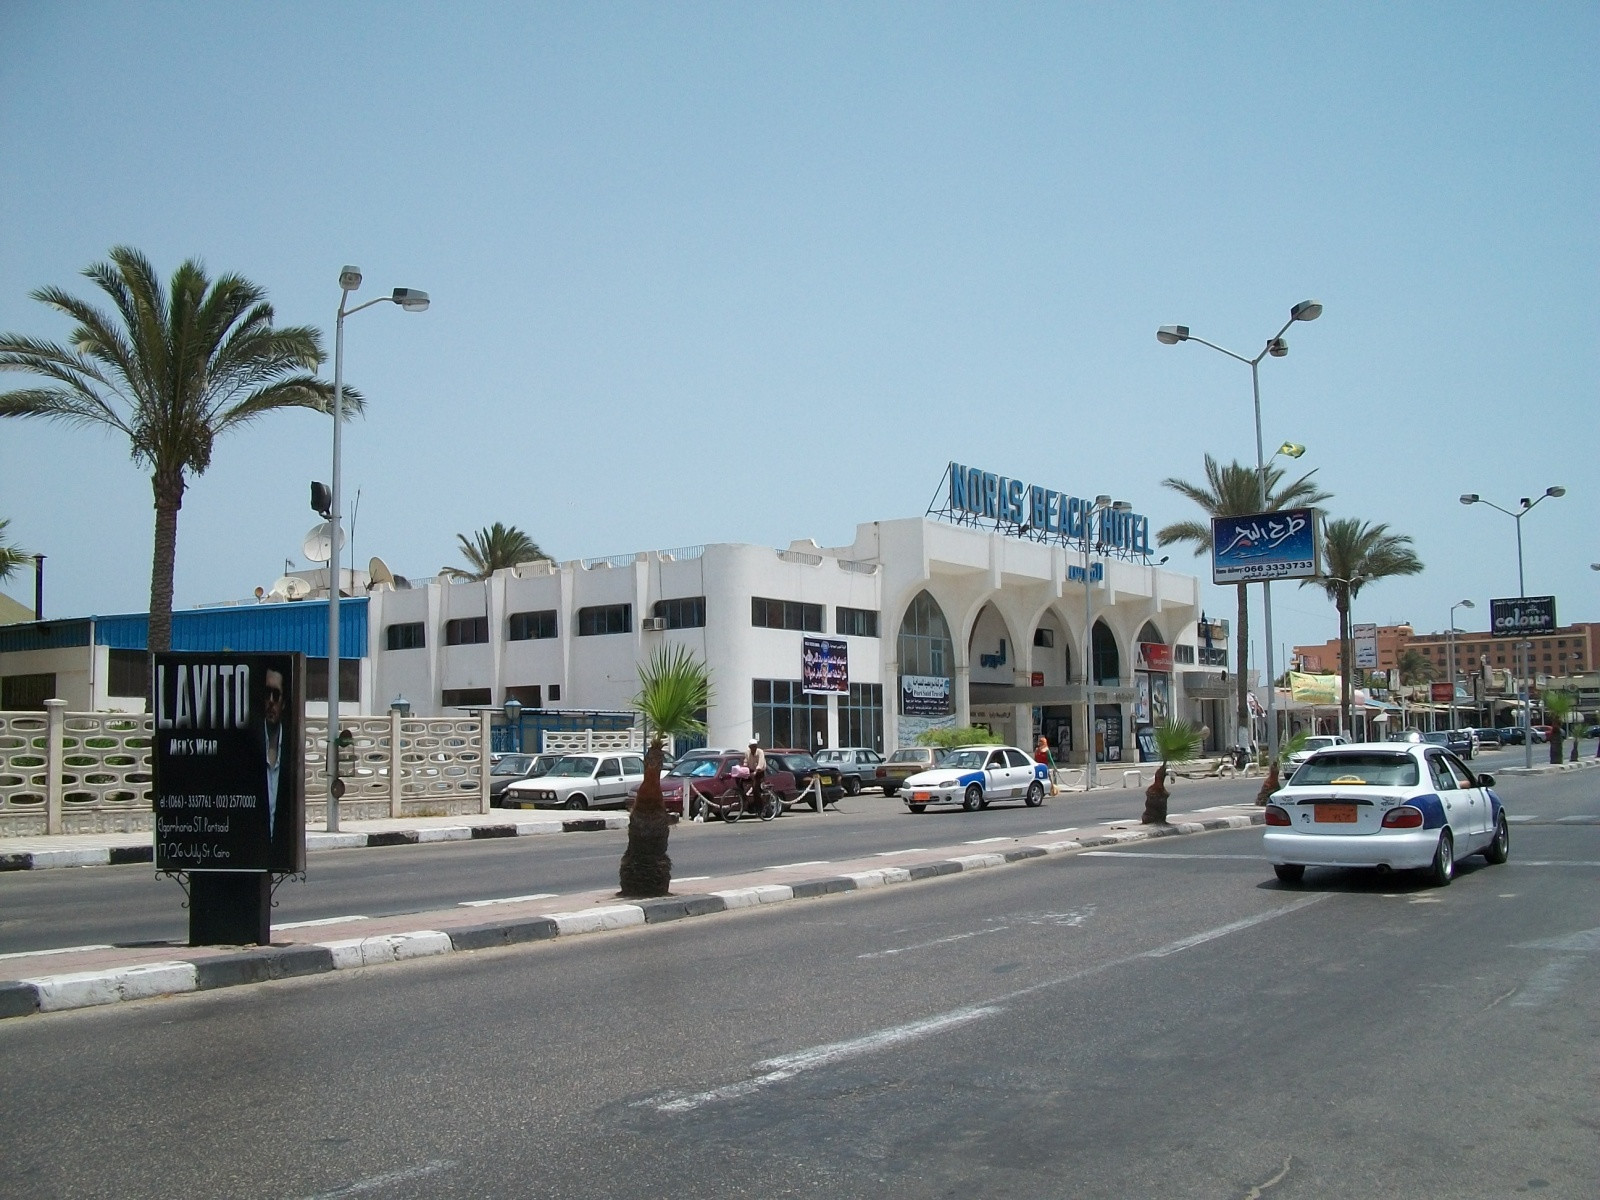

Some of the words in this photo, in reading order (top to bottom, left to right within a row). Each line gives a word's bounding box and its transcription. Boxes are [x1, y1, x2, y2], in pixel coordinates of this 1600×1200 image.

[950, 461, 1023, 525] NORAS
[1031, 485, 1093, 541] BEACH
[1099, 508, 1154, 556] HOTEL
[1244, 565, 1263, 573] 066
[1265, 561, 1313, 572] 3333733
[1495, 607, 1550, 628] colour
[158, 664, 250, 730] LAVITO
[195, 738, 218, 755] WEAR
[213, 844, 230, 858] Cairo
